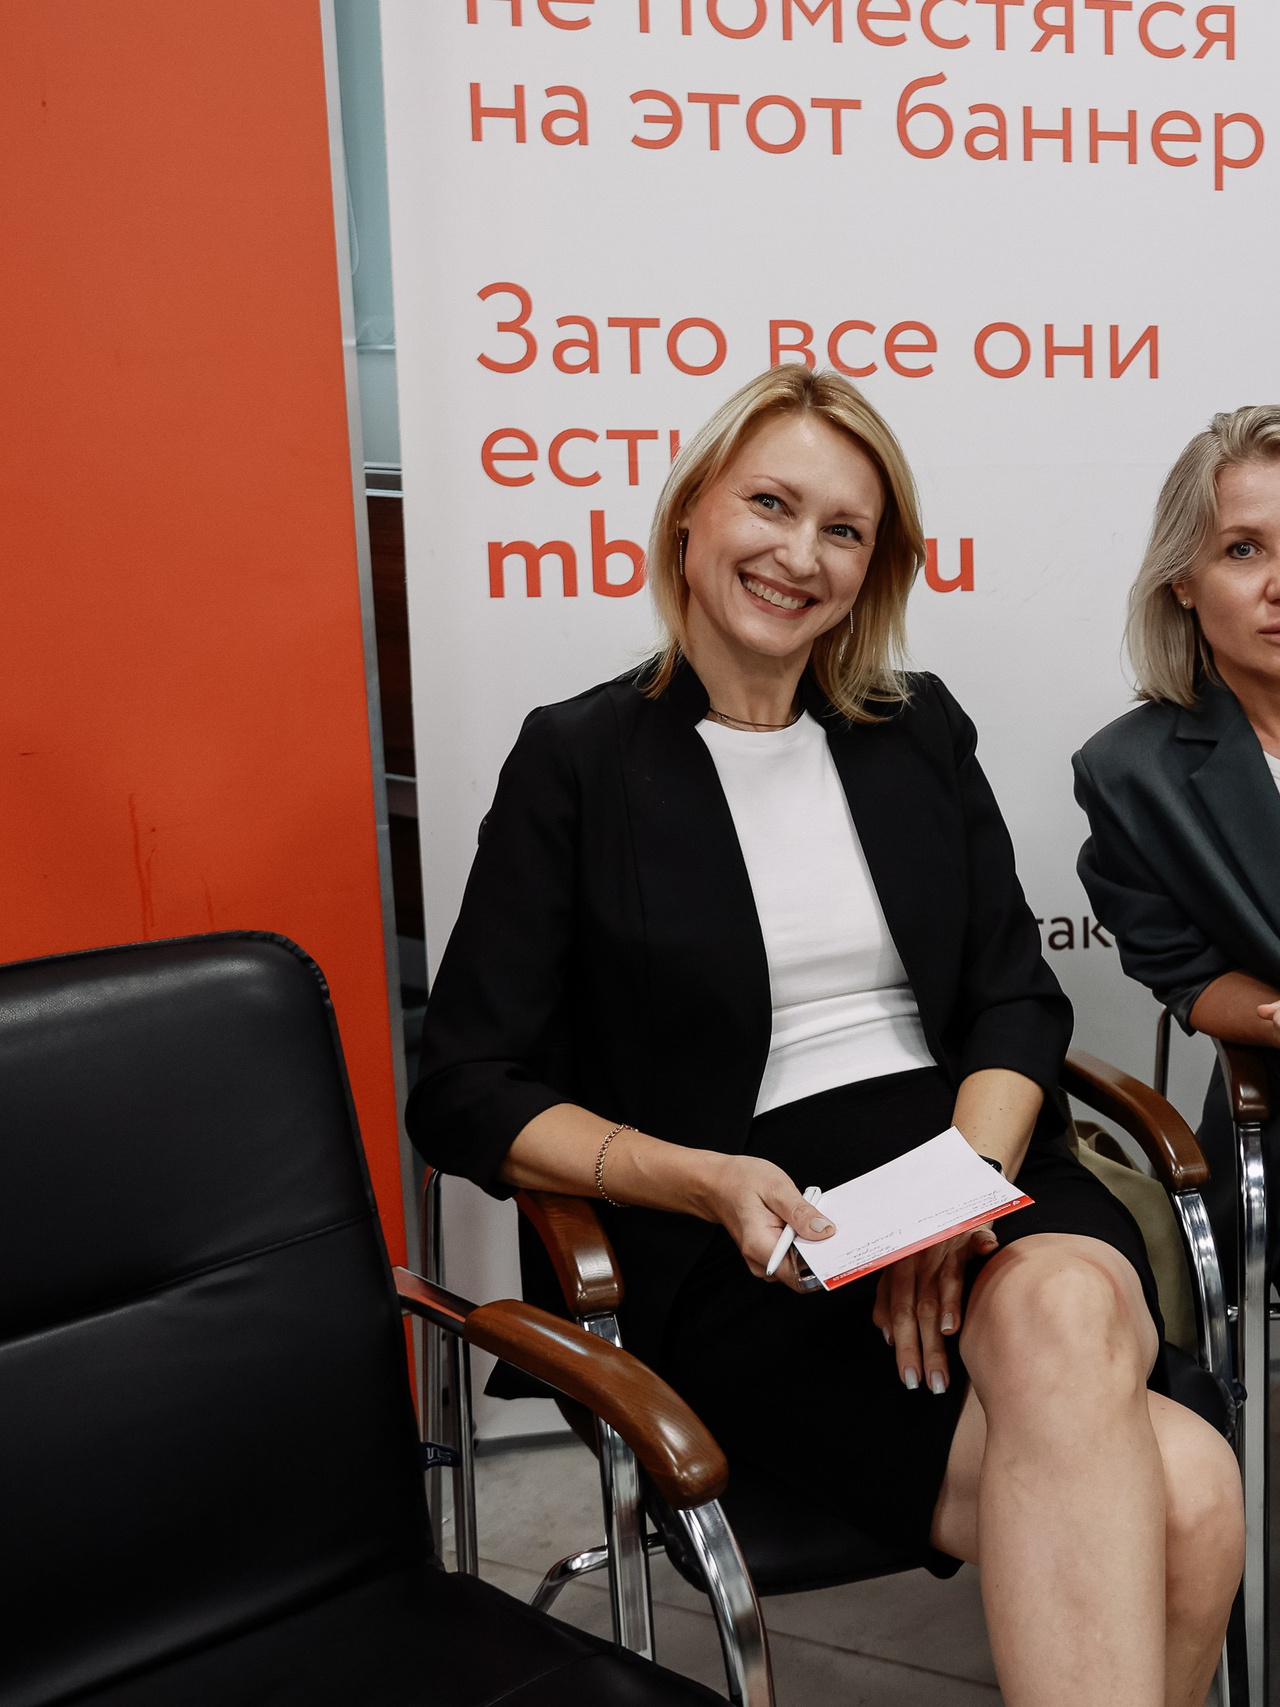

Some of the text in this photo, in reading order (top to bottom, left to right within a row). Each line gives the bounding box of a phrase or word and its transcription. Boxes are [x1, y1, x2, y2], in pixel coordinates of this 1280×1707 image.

[639, 0, 1236, 61] поместятся
[469, 72, 1265, 191] на этот баннер
[478, 282, 1159, 379] Зато все они
[1036, 916, 1113, 951] ак
